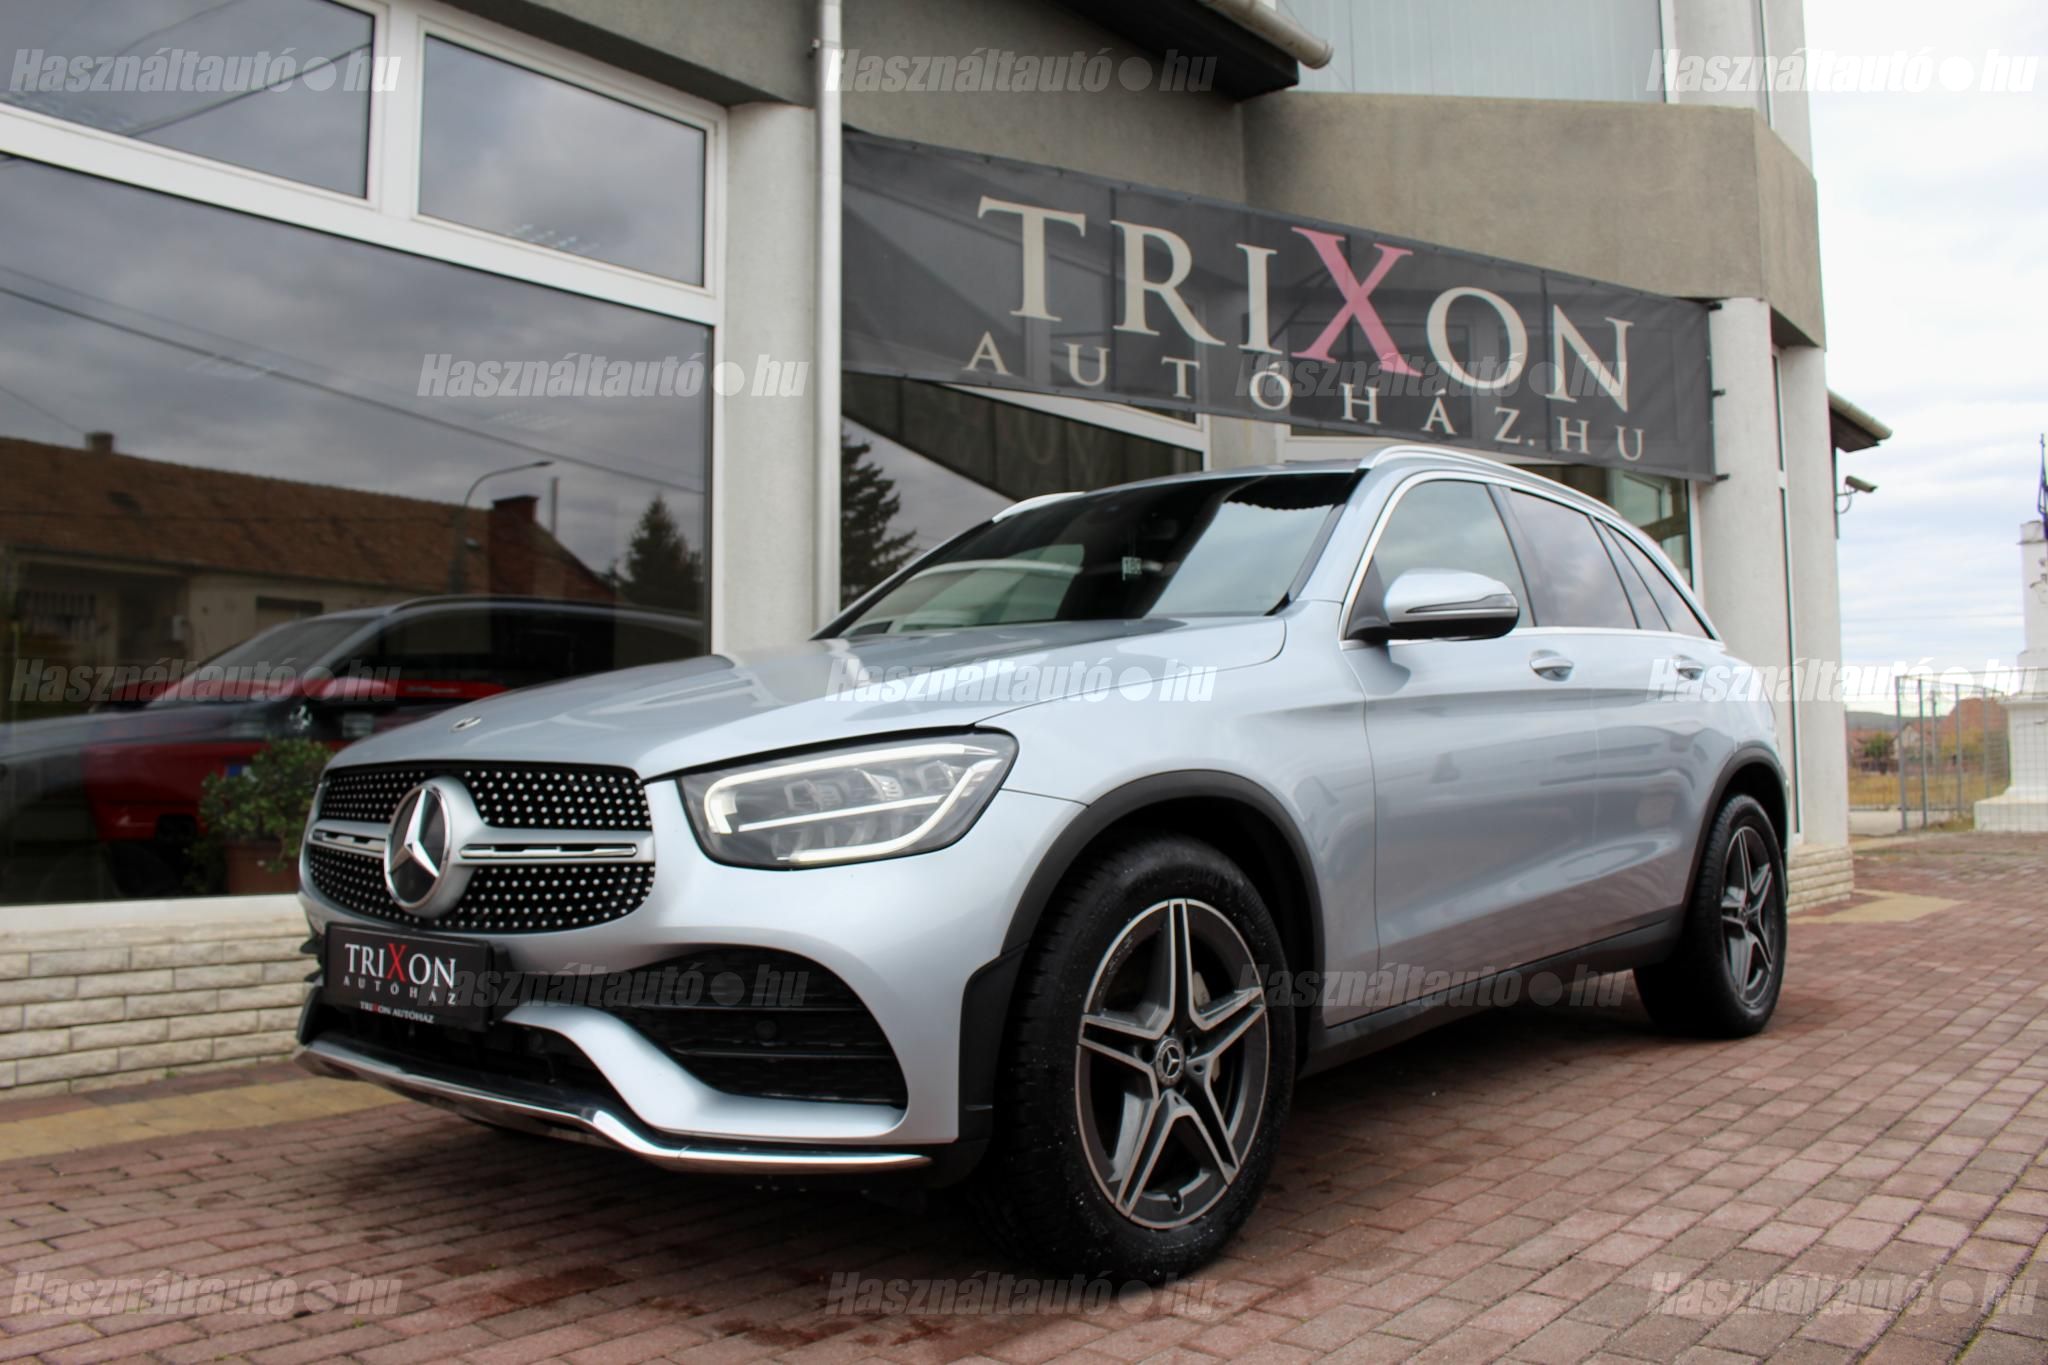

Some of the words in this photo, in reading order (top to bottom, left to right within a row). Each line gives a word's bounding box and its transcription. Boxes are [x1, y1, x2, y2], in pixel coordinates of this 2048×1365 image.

[977, 195, 1634, 412] TRIXON
[344, 943, 456, 989] TRIXON
[343, 976, 457, 1006] AUTÓHÁZ
